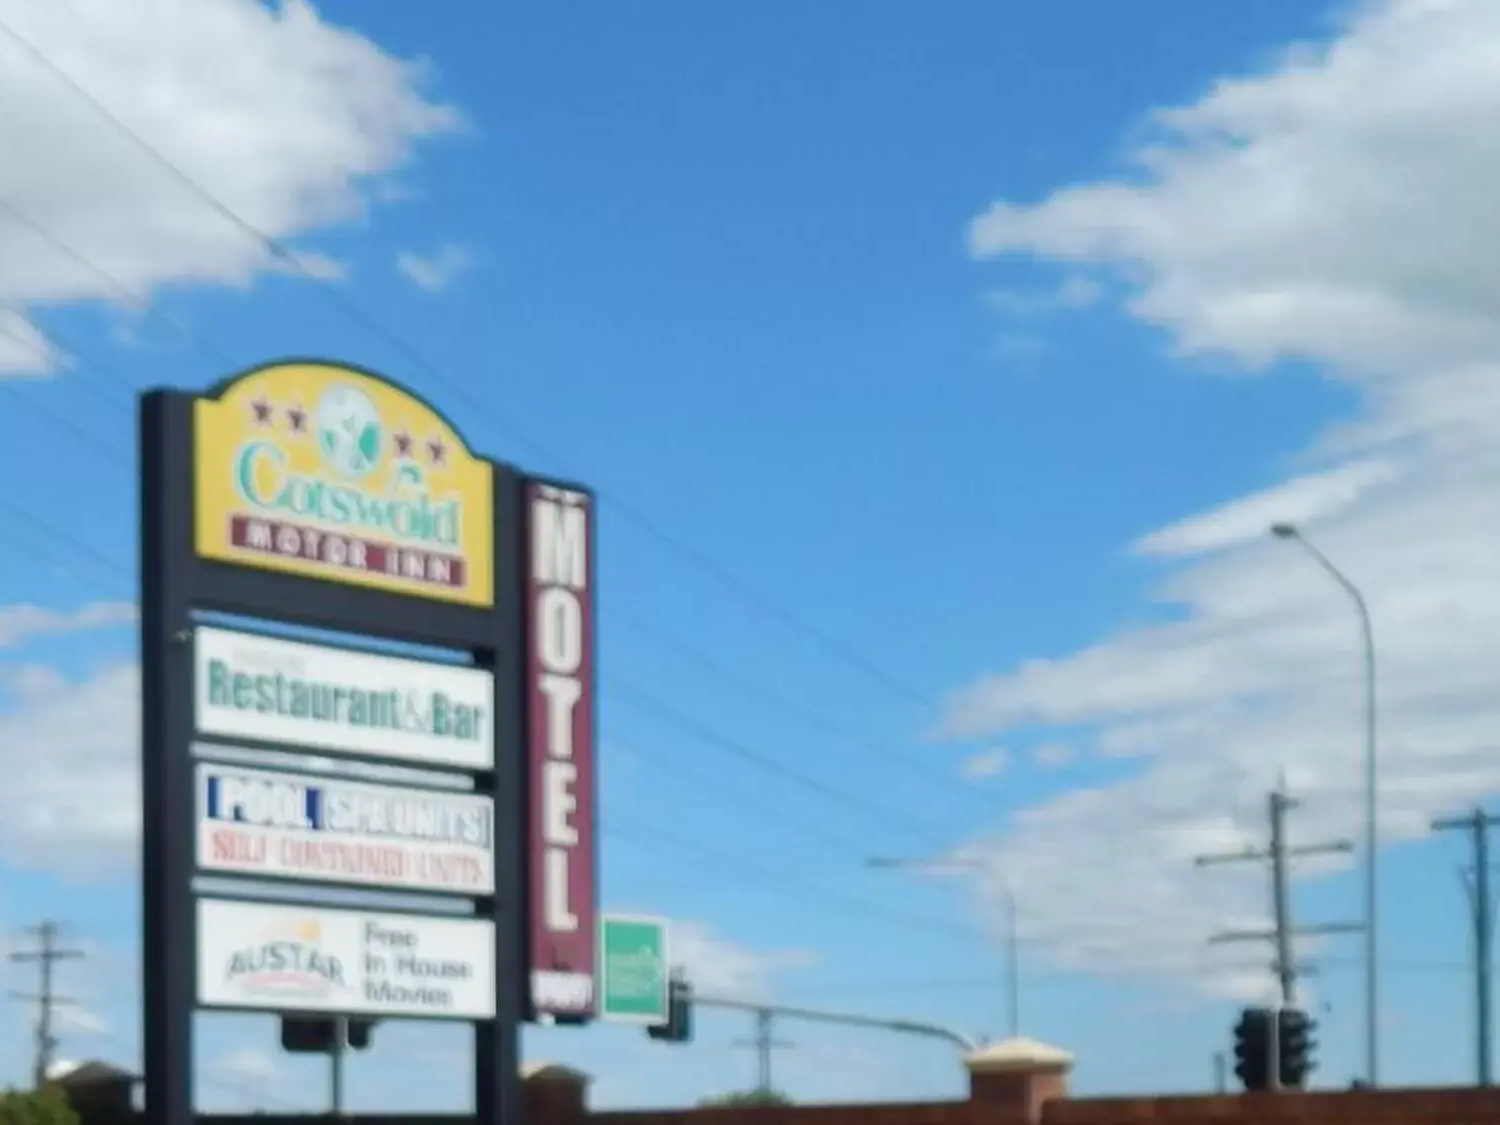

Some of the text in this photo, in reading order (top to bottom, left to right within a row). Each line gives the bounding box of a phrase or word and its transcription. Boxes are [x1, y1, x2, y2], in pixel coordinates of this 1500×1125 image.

[236, 440, 461, 545] Cotswold
[246, 517, 450, 581] MOTOR INN
[533, 500, 586, 929] MOTEL
[364, 921, 419, 947] Free
[226, 940, 346, 987] AUSTAR
[397, 955, 474, 979] House
[364, 979, 451, 1006] Movies
